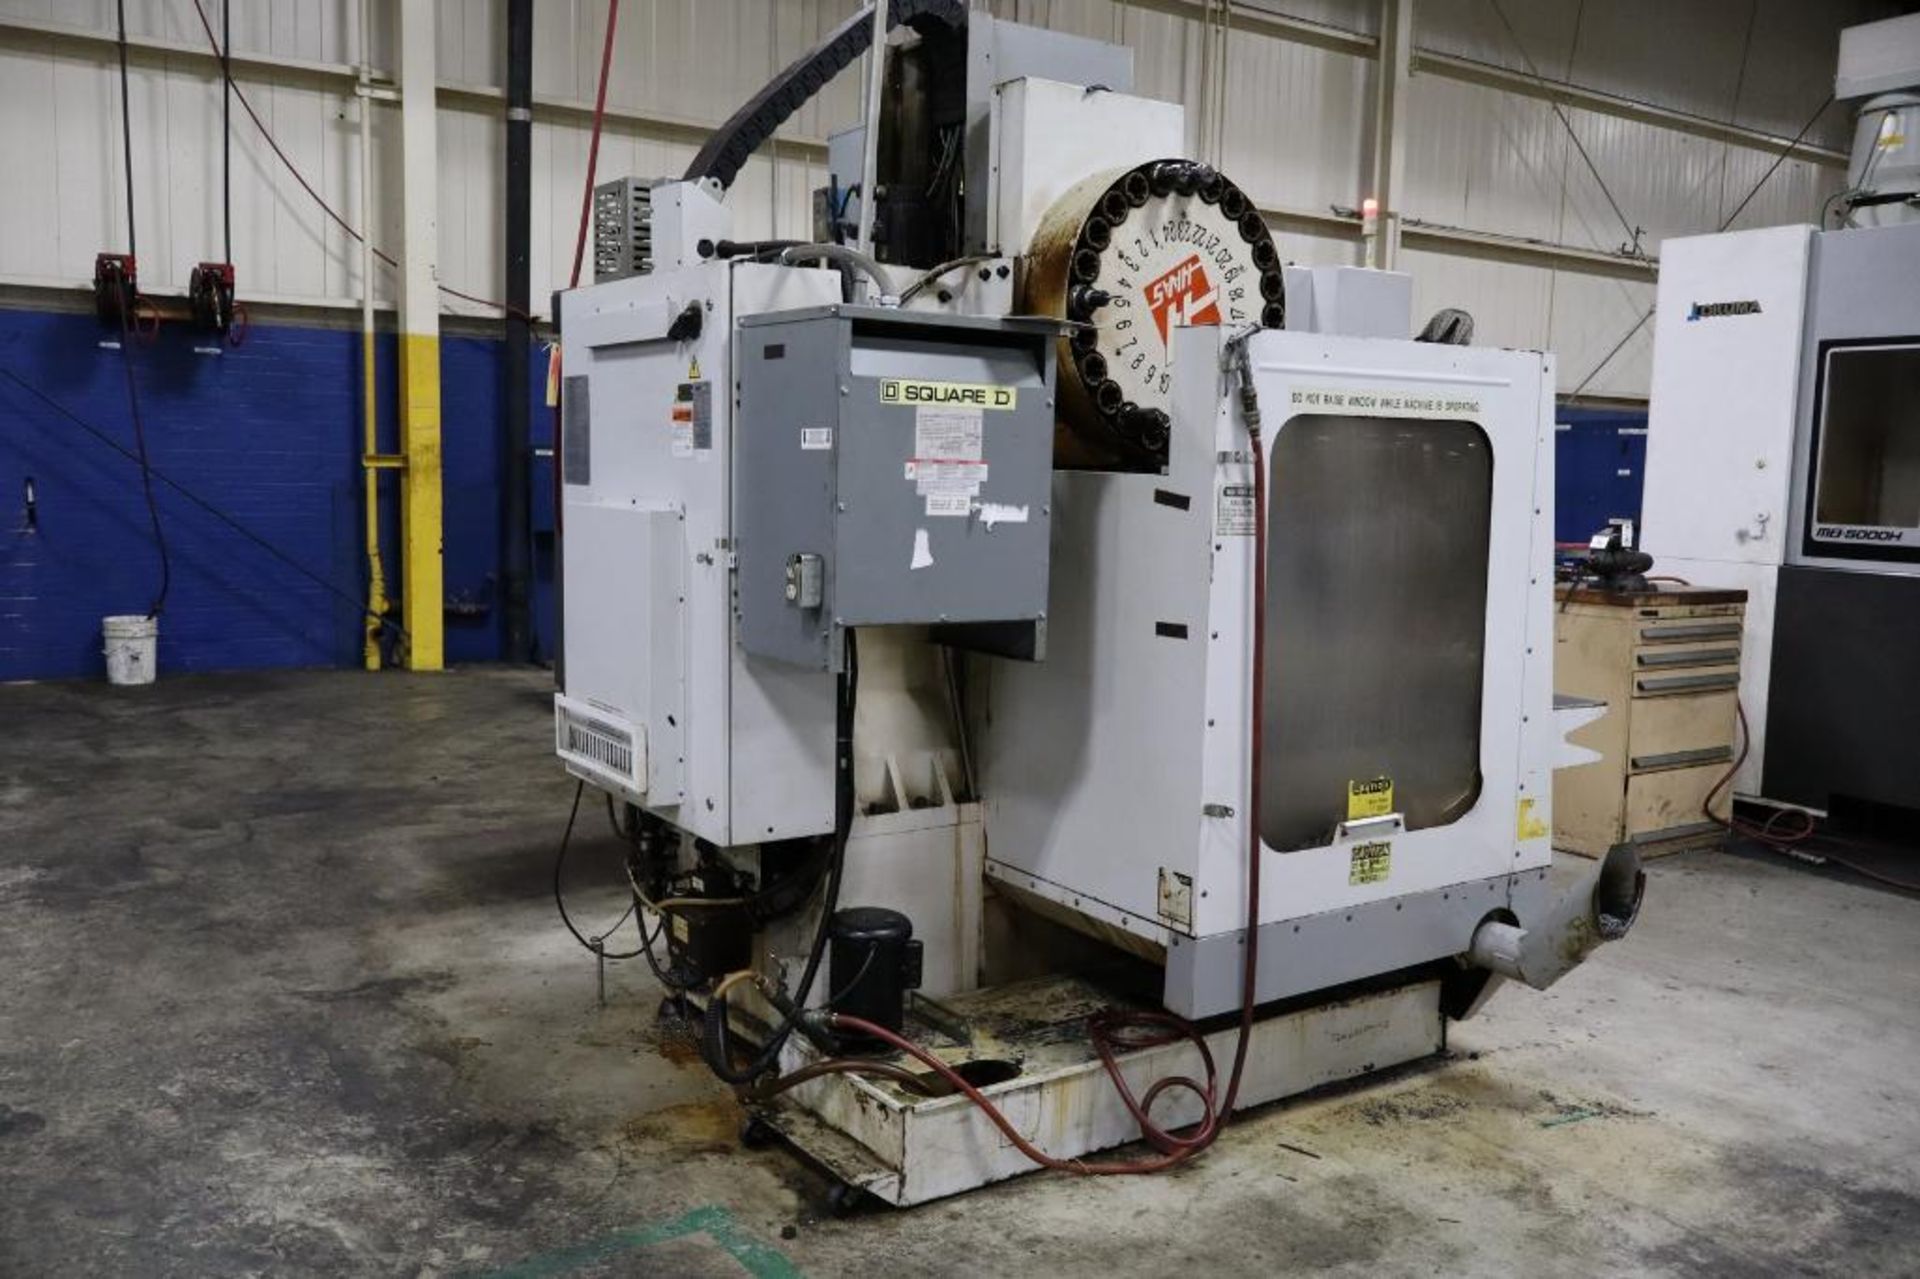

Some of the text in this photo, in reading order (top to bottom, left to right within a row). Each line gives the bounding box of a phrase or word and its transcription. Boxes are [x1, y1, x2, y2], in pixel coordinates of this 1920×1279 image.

[1135, 239, 1148, 257] 2
[1124, 256, 1139, 272] 3
[1116, 320, 1132, 331] 6
[1120, 336, 1138, 349] 7
[1130, 353, 1145, 370] 8
[1144, 365, 1156, 385] 9
[904, 385, 986, 404] SQUARE
[994, 390, 1011, 406] D
